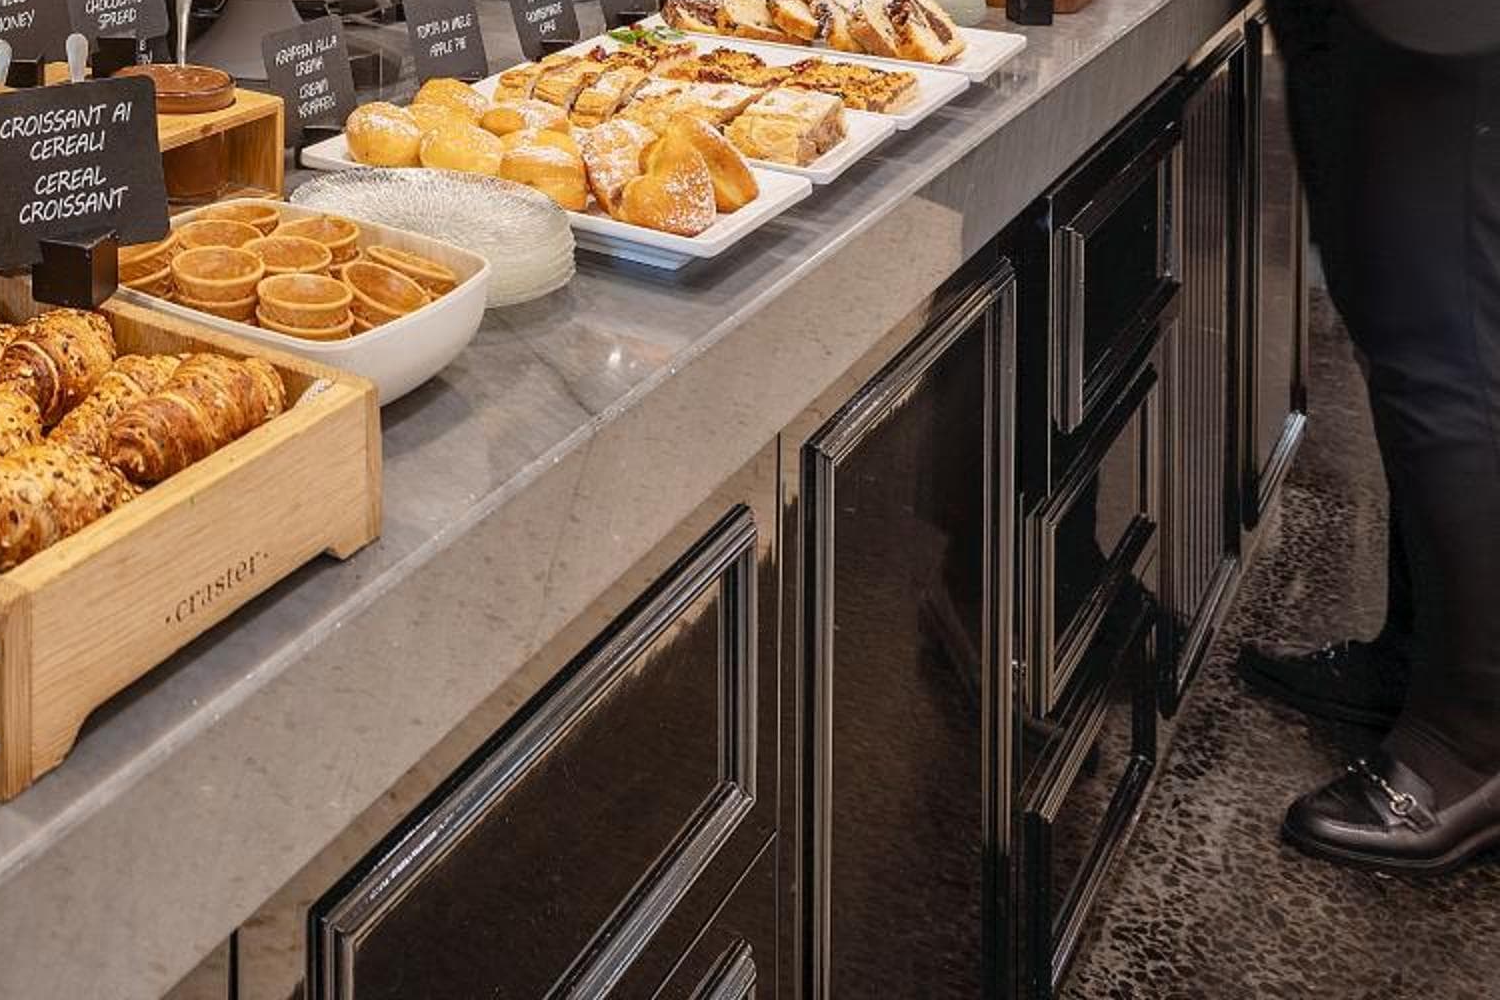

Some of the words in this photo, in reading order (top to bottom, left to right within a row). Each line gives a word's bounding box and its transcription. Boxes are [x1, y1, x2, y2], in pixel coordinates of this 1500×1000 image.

[0, 104, 107, 139] CROISSANT
[112, 101, 133, 123] AI
[29, 130, 106, 161] CEREALI
[34, 165, 107, 196] CEREAL
[19, 186, 129, 224] CROISSANT
